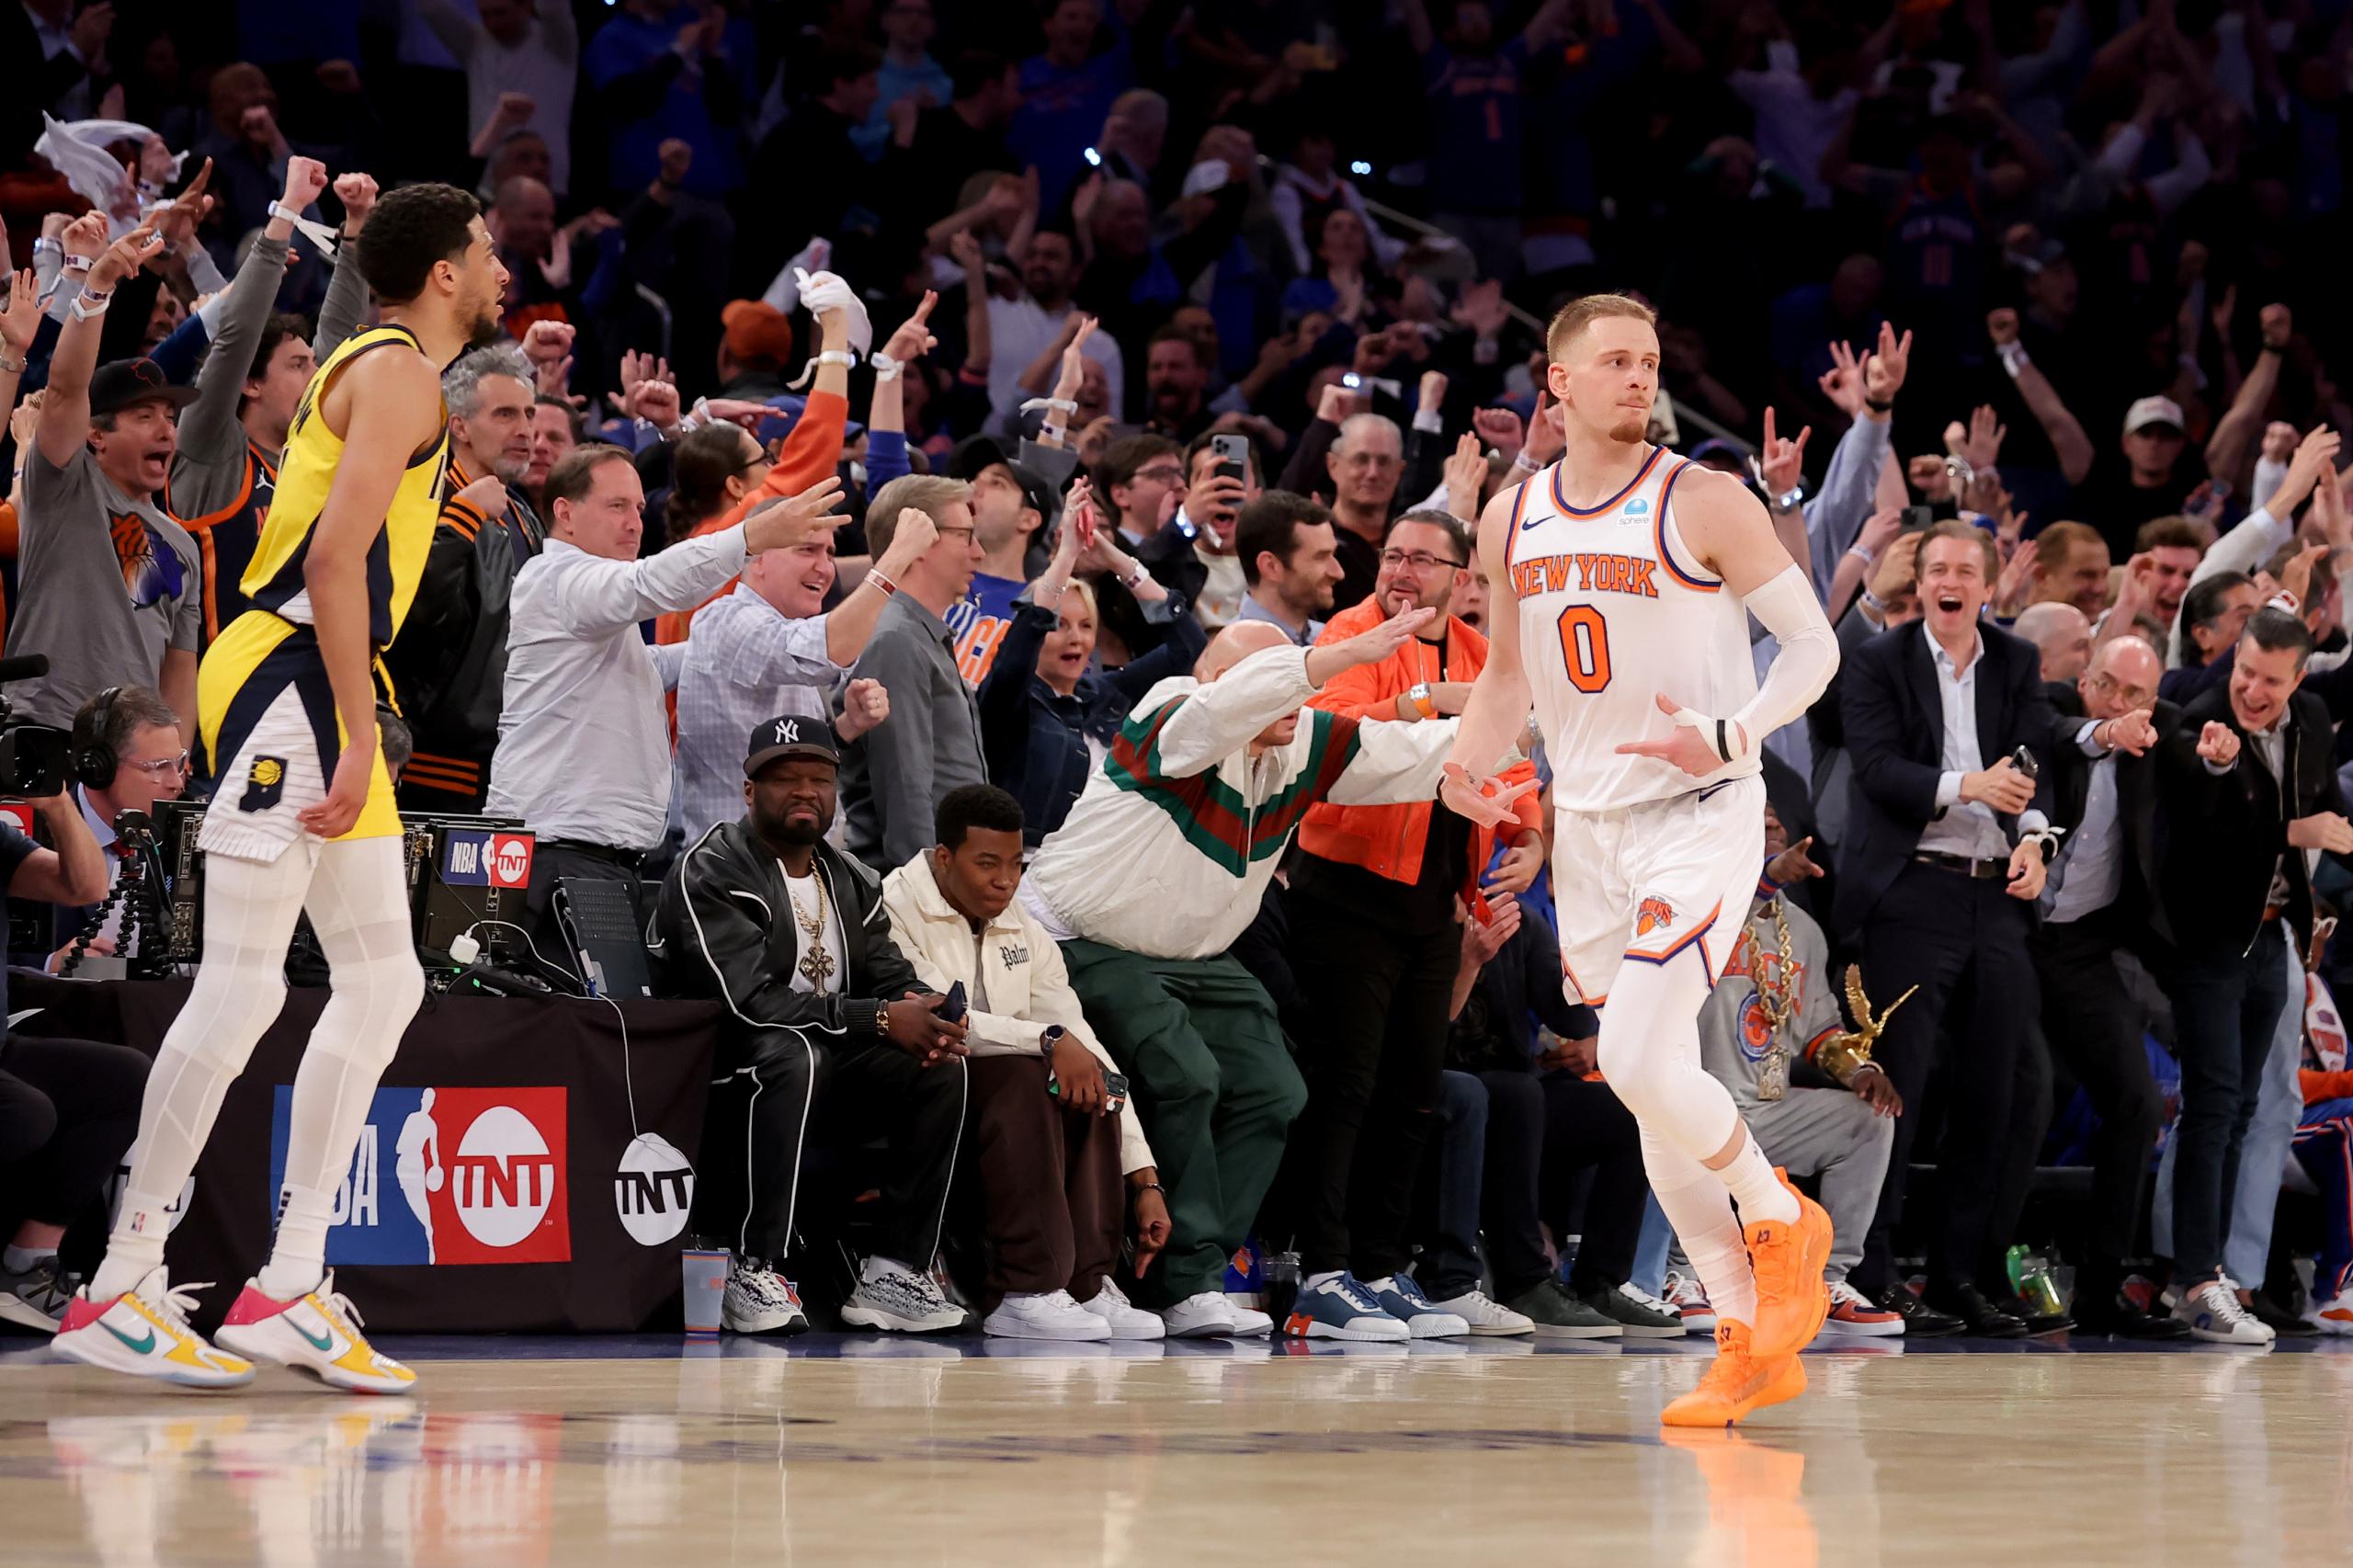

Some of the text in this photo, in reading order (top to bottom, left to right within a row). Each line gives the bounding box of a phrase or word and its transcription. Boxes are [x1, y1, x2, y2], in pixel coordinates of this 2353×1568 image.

[1619, 516, 1651, 526] sphere
[1512, 553, 1659, 600] NEW YORK
[1557, 603, 1612, 694] 0
[775, 719, 799, 744] NY
[450, 841, 527, 874] NBA TNT
[999, 943, 1029, 971] Palm
[455, 1153, 553, 1208] TNT
[615, 1168, 694, 1215] TNT
